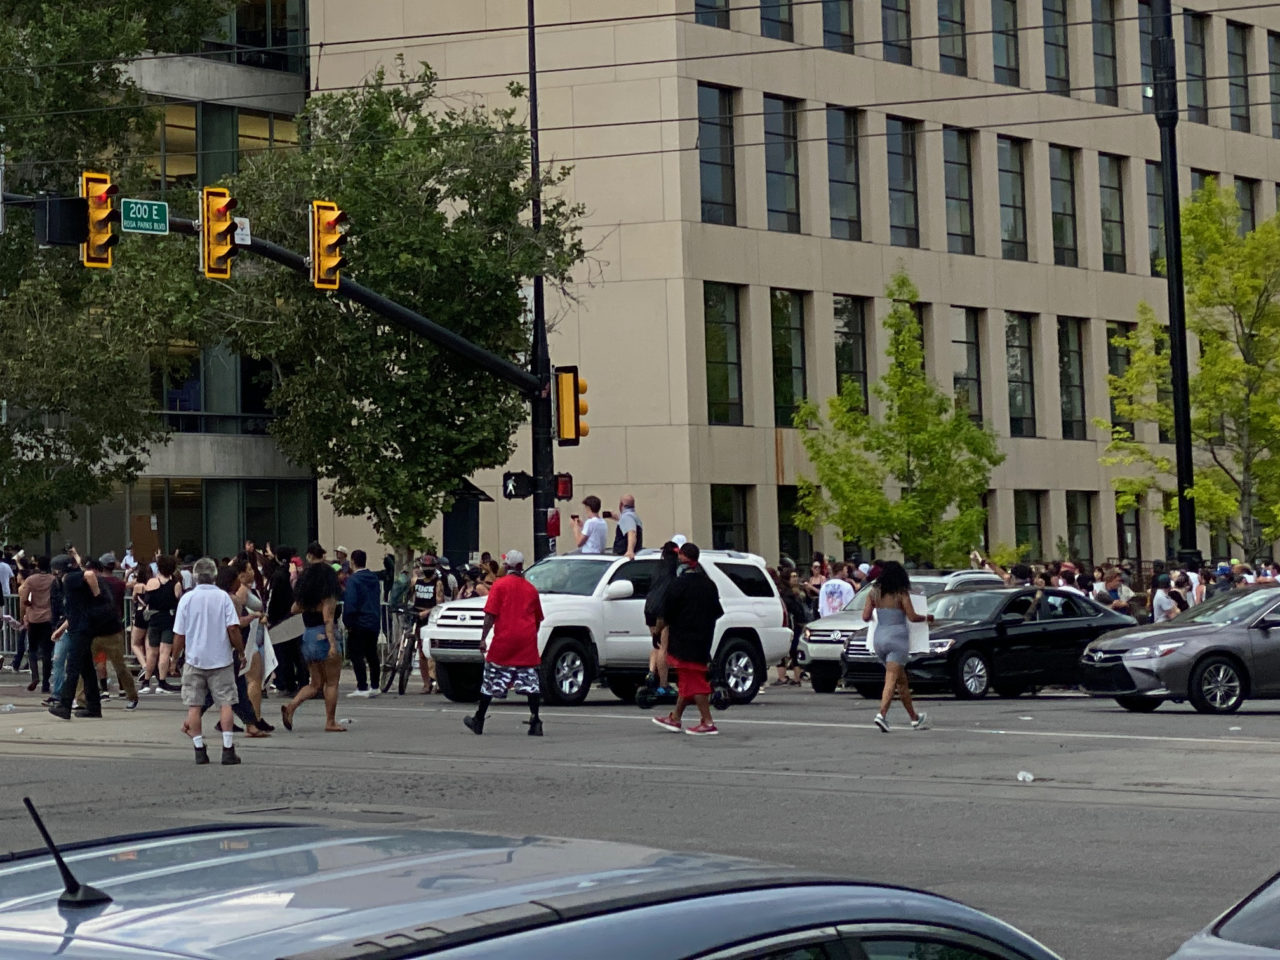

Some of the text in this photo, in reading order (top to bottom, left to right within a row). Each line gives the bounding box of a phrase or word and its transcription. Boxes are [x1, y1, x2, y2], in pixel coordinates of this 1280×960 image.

[130, 204, 149, 219] 200
[124, 220, 136, 228] ROSA
[137, 221, 152, 229] PARKS
